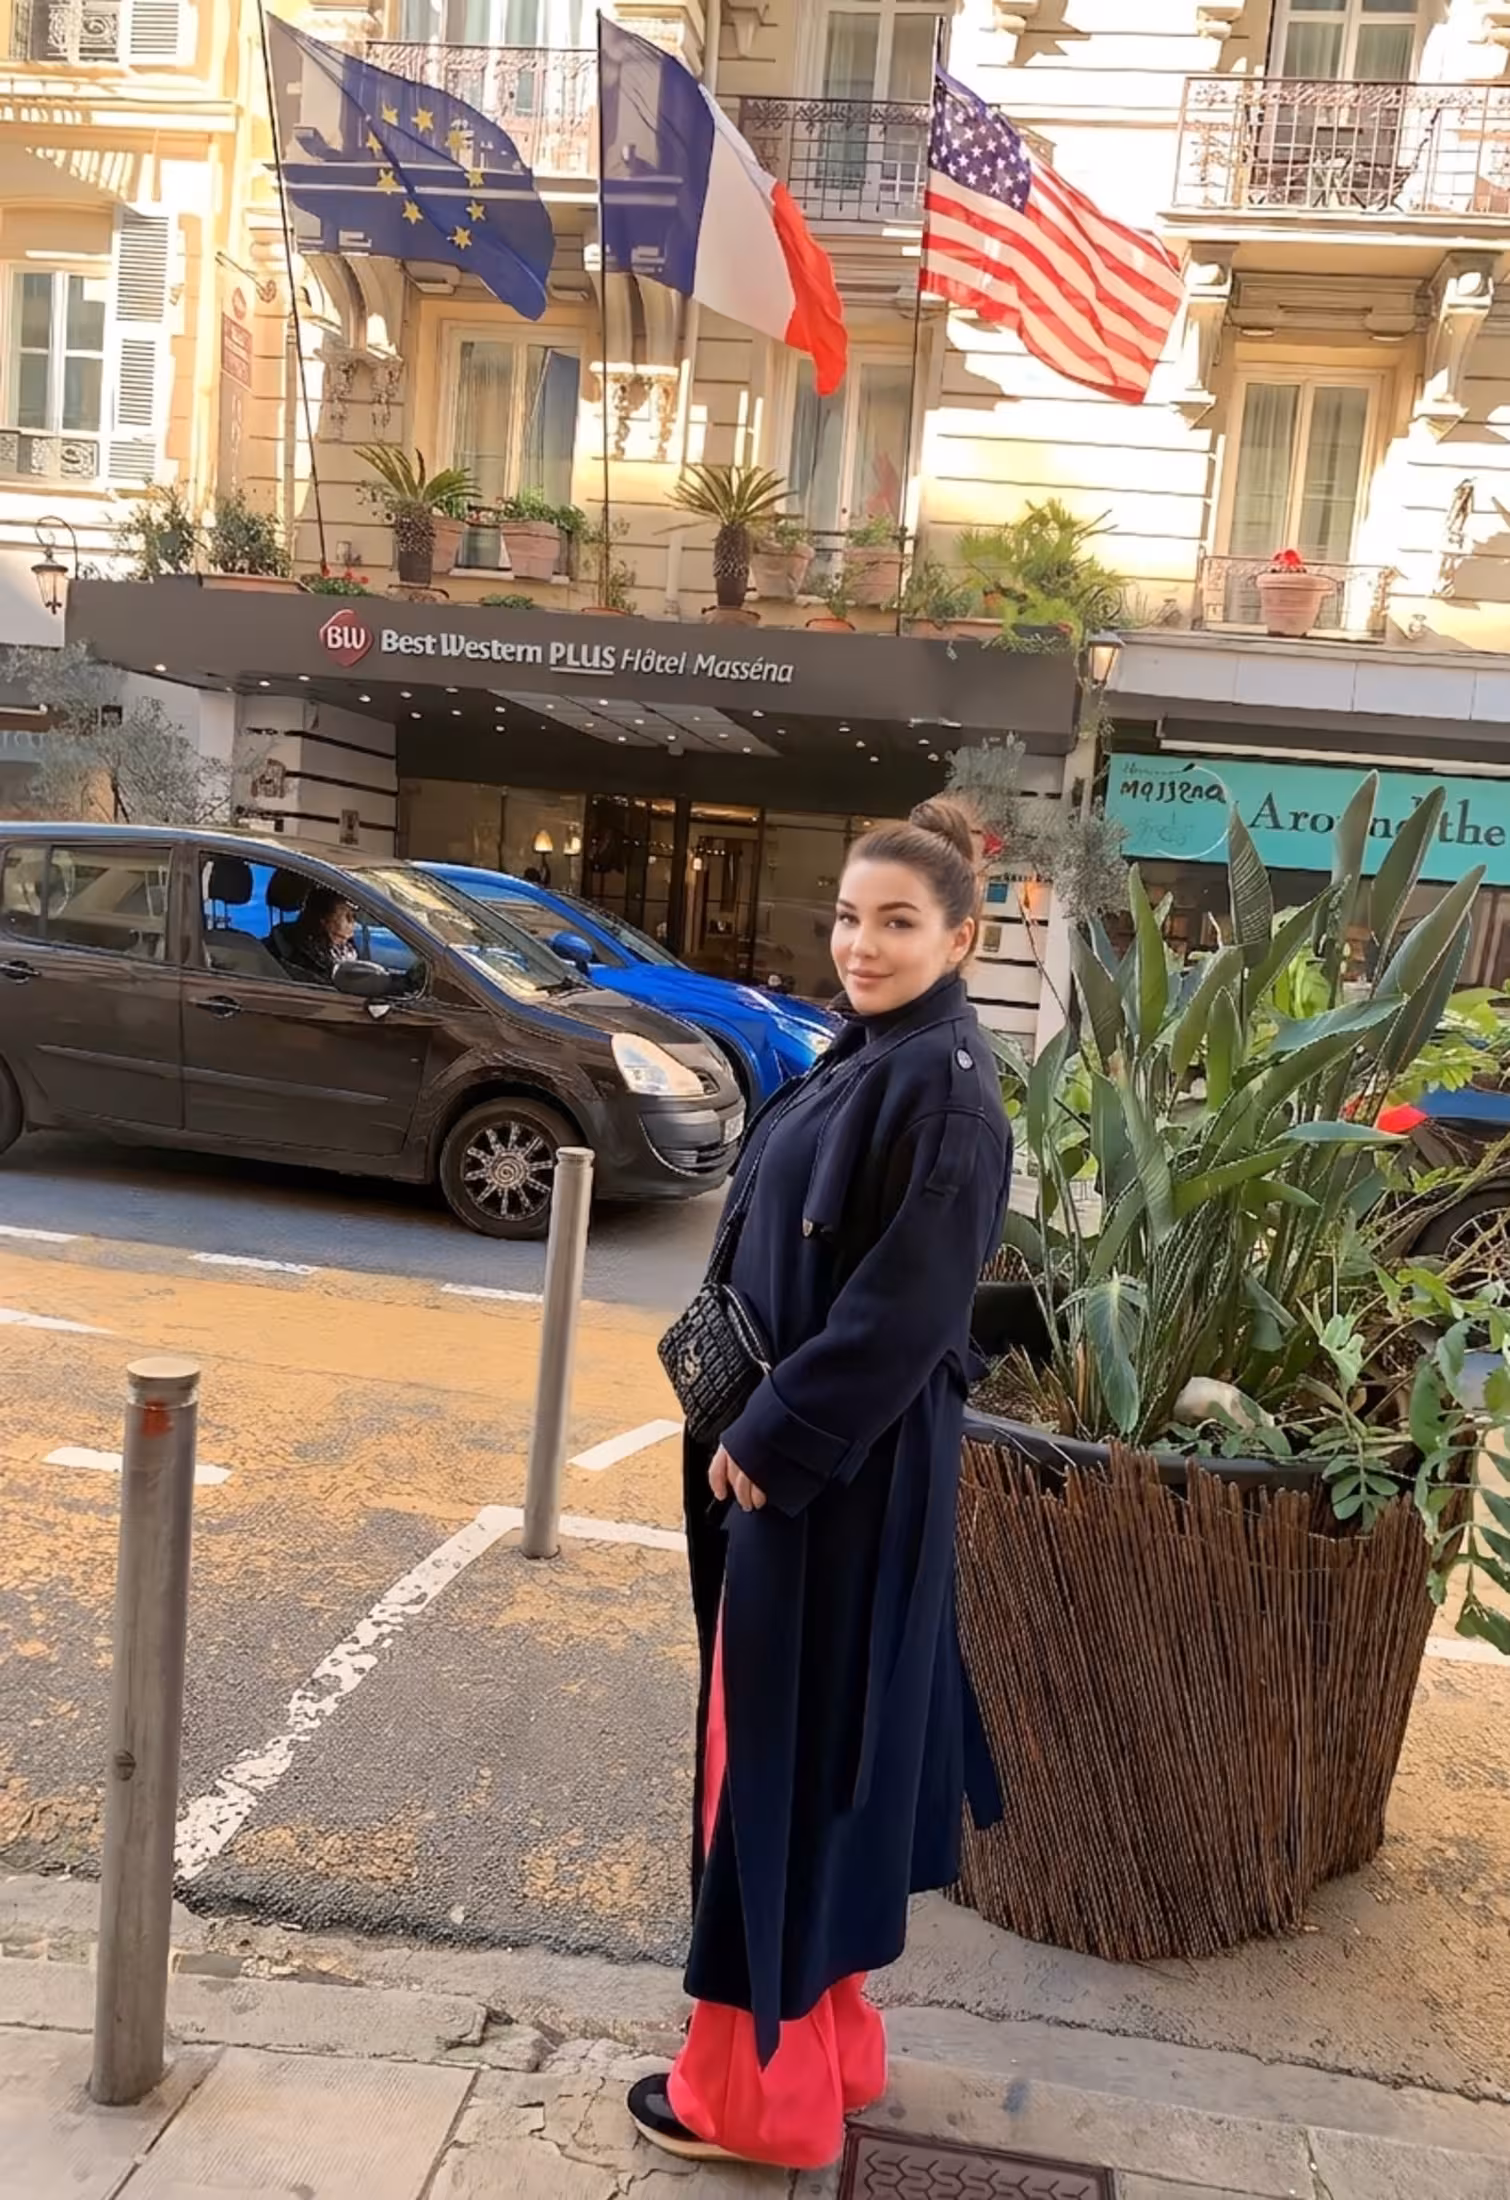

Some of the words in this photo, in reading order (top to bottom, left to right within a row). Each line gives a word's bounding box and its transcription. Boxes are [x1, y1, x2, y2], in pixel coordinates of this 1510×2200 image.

[327, 625, 366, 650] BW
[381, 629, 437, 655] Best
[440, 633, 543, 664] Western
[550, 641, 616, 675] PLUS
[620, 648, 687, 675] Hôtel
[693, 653, 794, 683] Masséna
[1438, 799, 1506, 847] the
